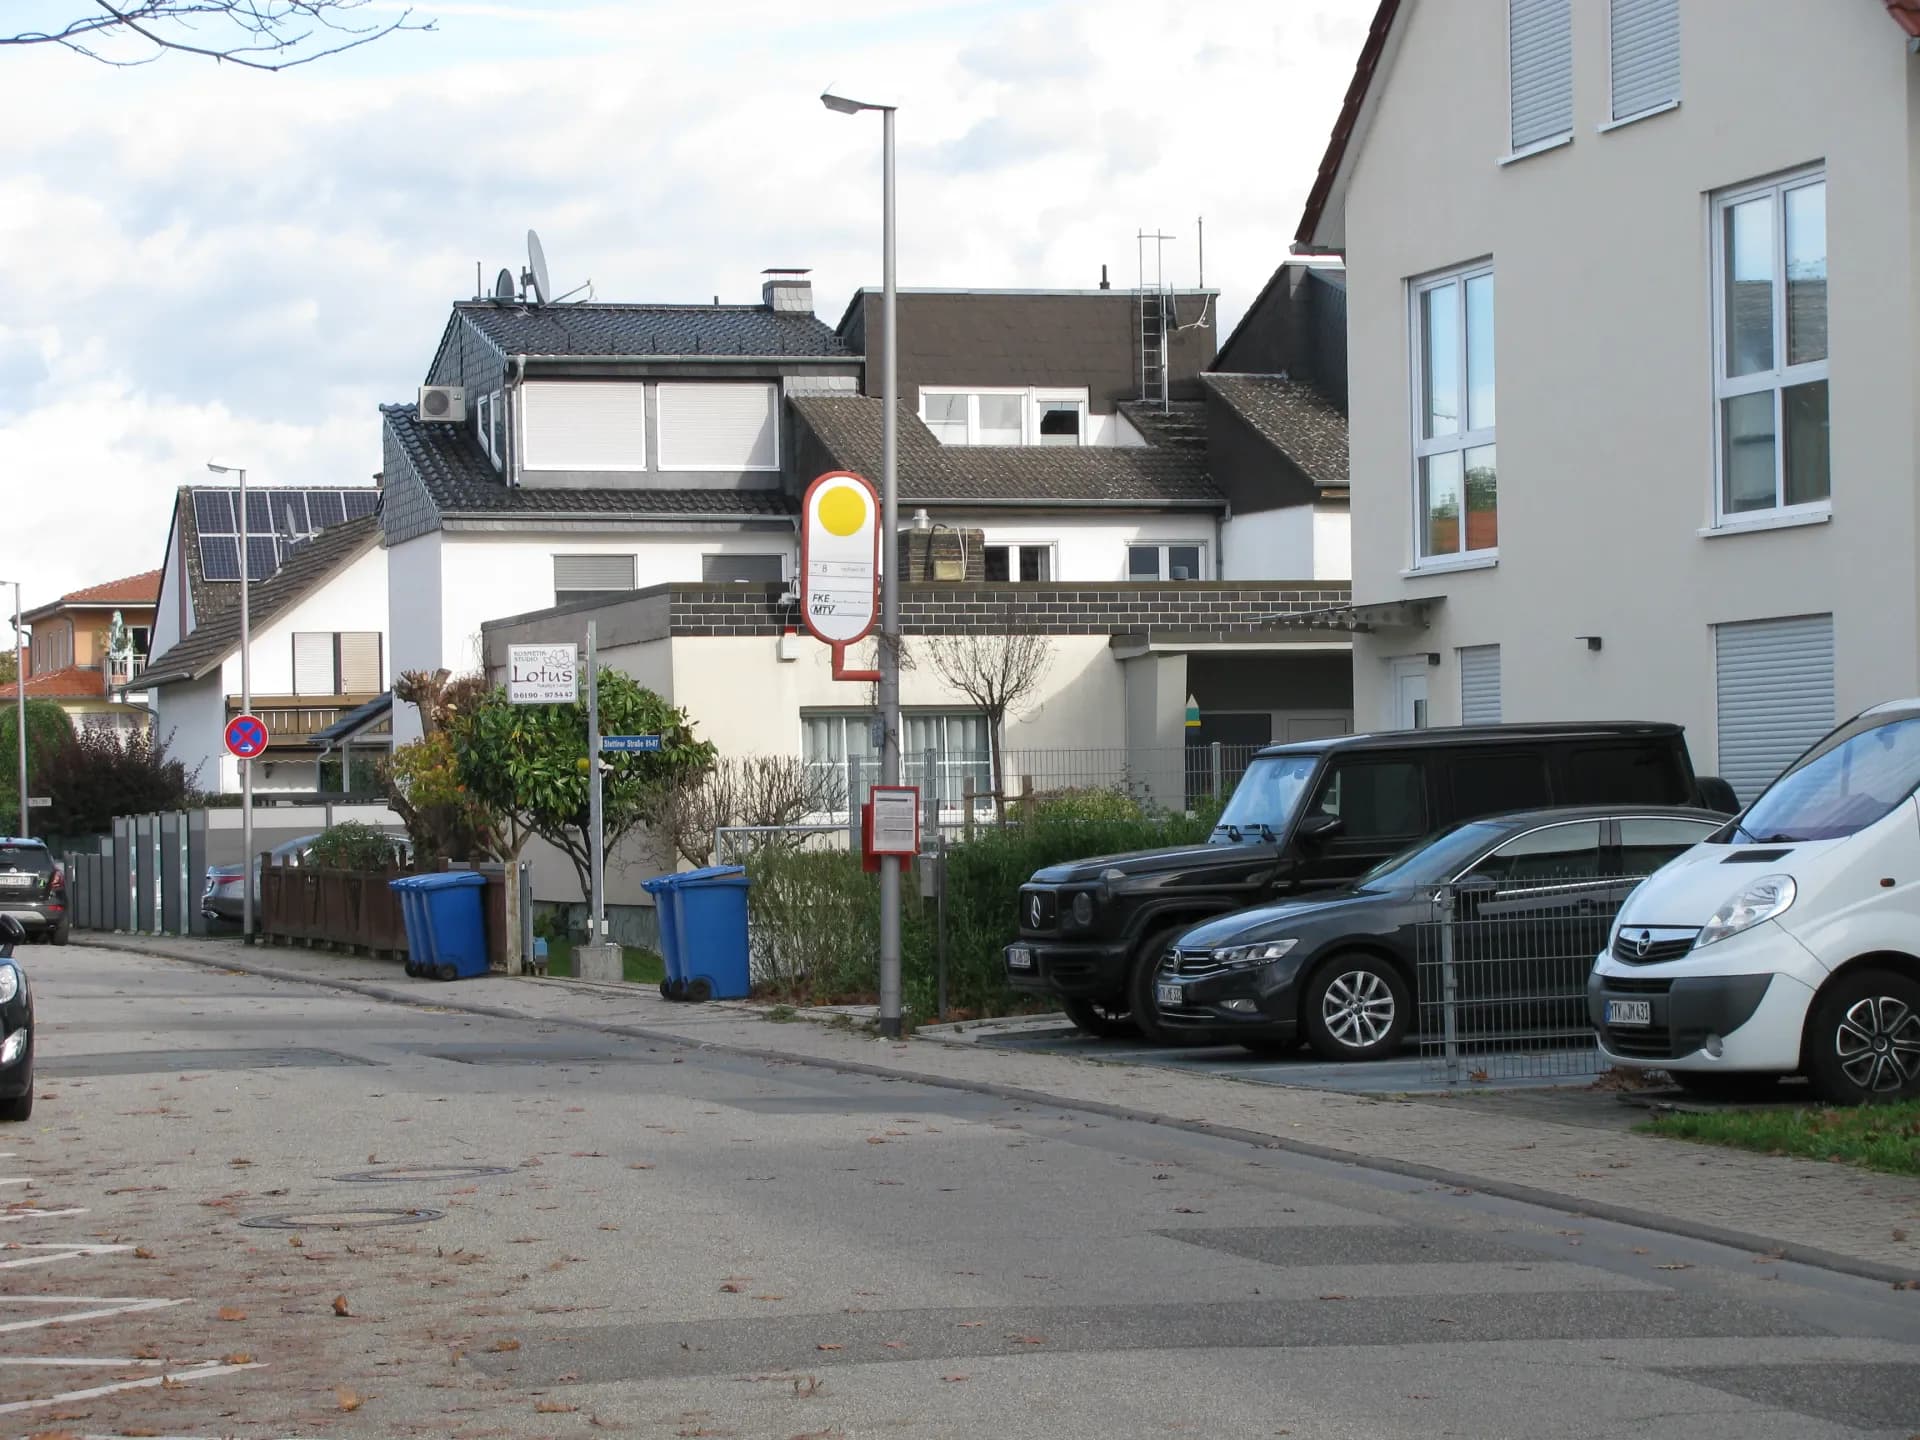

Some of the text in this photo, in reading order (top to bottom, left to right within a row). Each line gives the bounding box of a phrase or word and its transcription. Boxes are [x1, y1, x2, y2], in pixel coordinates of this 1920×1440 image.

[812, 593, 831, 603] FKE
[813, 604, 836, 616] MTV
[511, 665, 573, 683] Lotus
[604, 739, 626, 748] Stettiner
[627, 739, 644, 748] Straße
